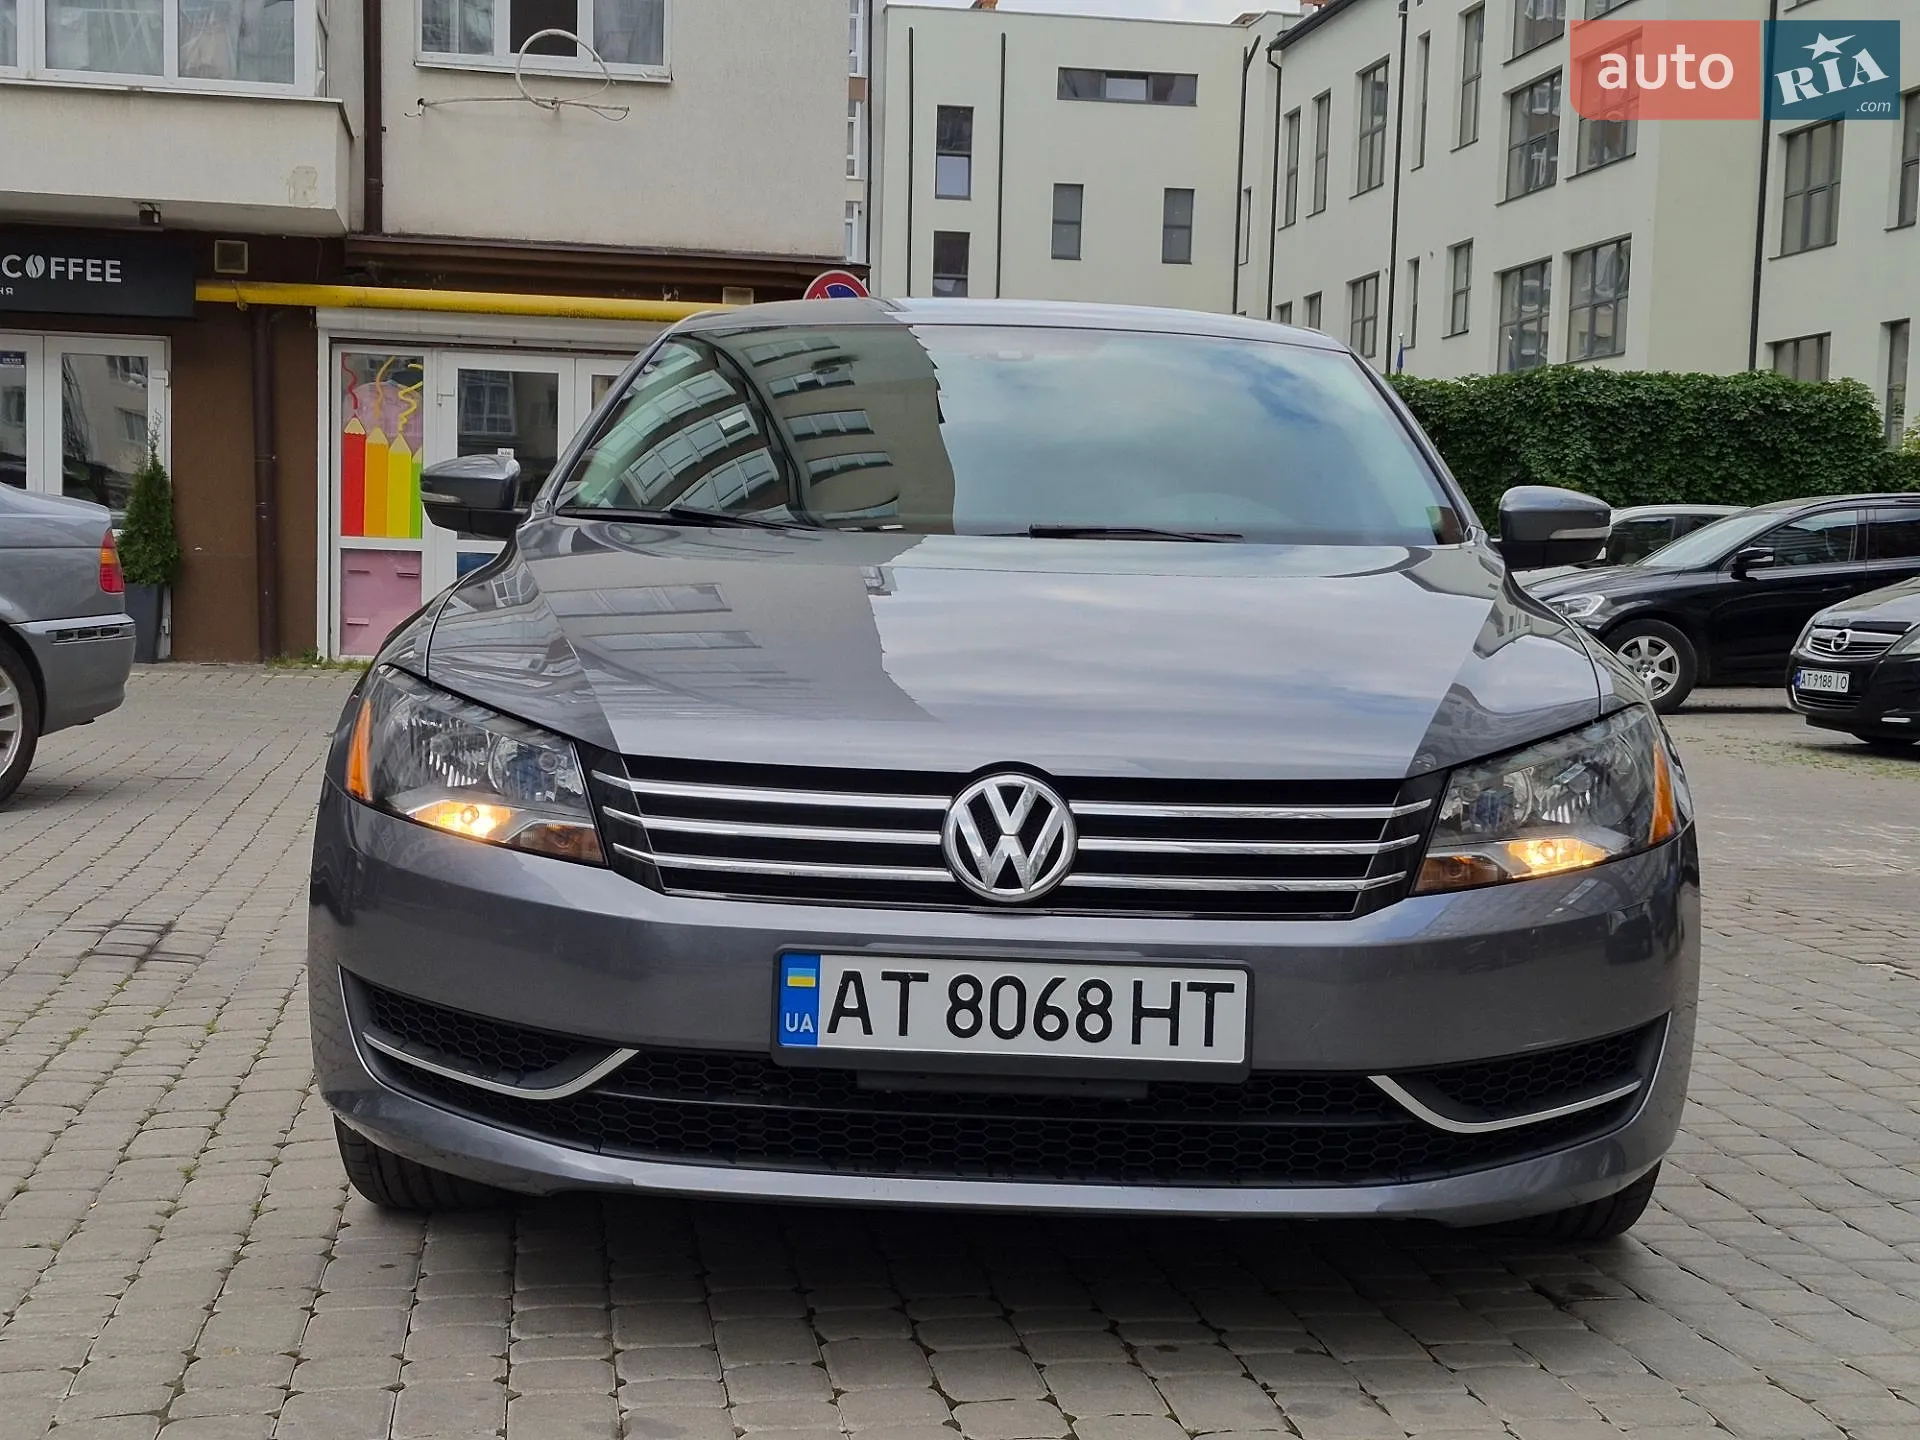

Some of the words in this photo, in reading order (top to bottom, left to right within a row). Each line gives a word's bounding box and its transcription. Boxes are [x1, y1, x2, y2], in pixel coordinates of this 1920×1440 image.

[1, 253, 122, 283] COFFEE
[1801, 673, 1813, 687] AT
[1813, 674, 1833, 688] 9188
[949, 778, 1071, 897] VW
[785, 1012, 814, 1033] UA
[826, 970, 929, 1037] AT
[945, 973, 1113, 1043] 8068
[1131, 979, 1235, 1048] HT
